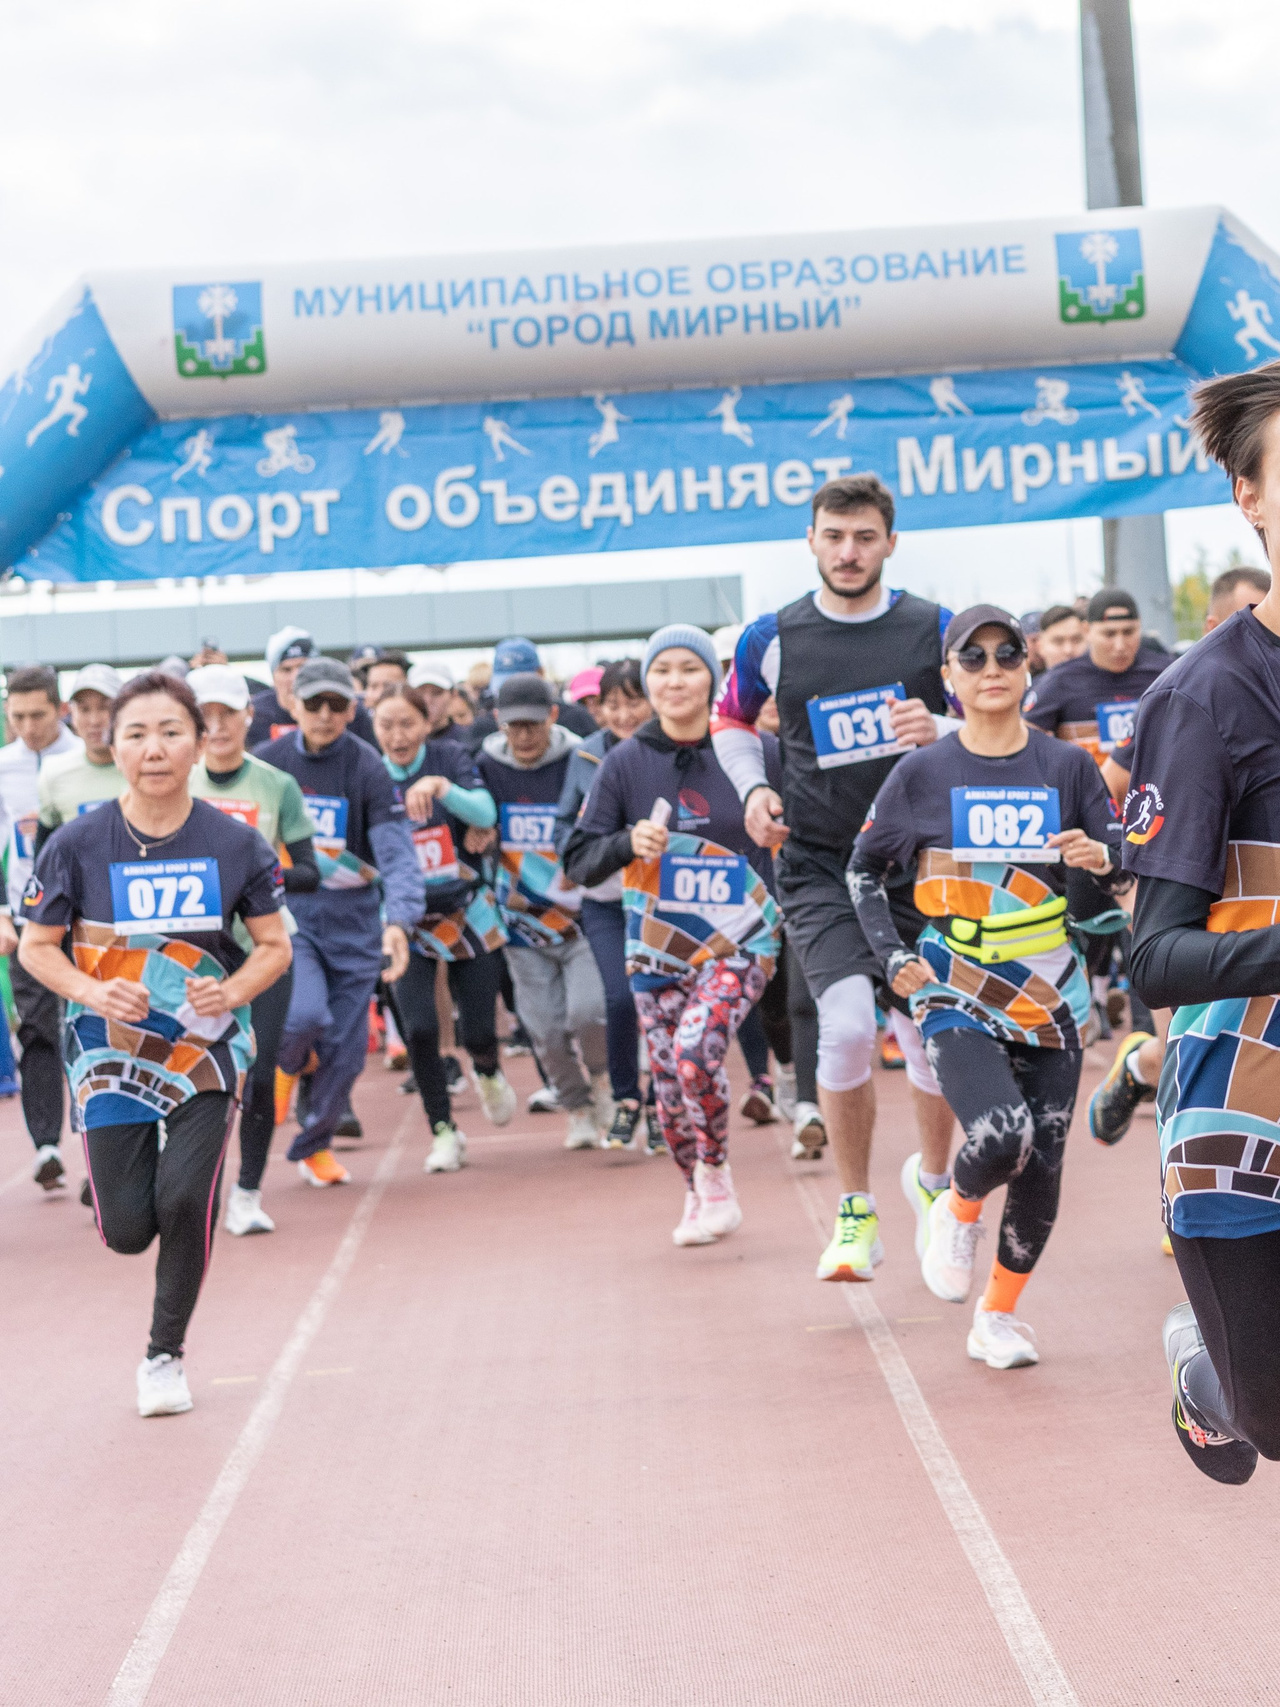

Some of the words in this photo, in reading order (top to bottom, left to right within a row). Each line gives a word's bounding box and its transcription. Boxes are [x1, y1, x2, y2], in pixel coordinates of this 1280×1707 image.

[294, 266, 692, 317] МУНИЦИПАЛЬНОЕ
[706, 244, 1027, 293] ОБРАЗОВАНИЕ
[102, 483, 341, 554] Спорт
[897, 414, 1210, 502] Мирный
[828, 703, 898, 750] 031
[508, 815, 557, 842] 057
[968, 804, 1044, 847] 082
[127, 875, 206, 919] 072
[674, 868, 731, 903] 016
